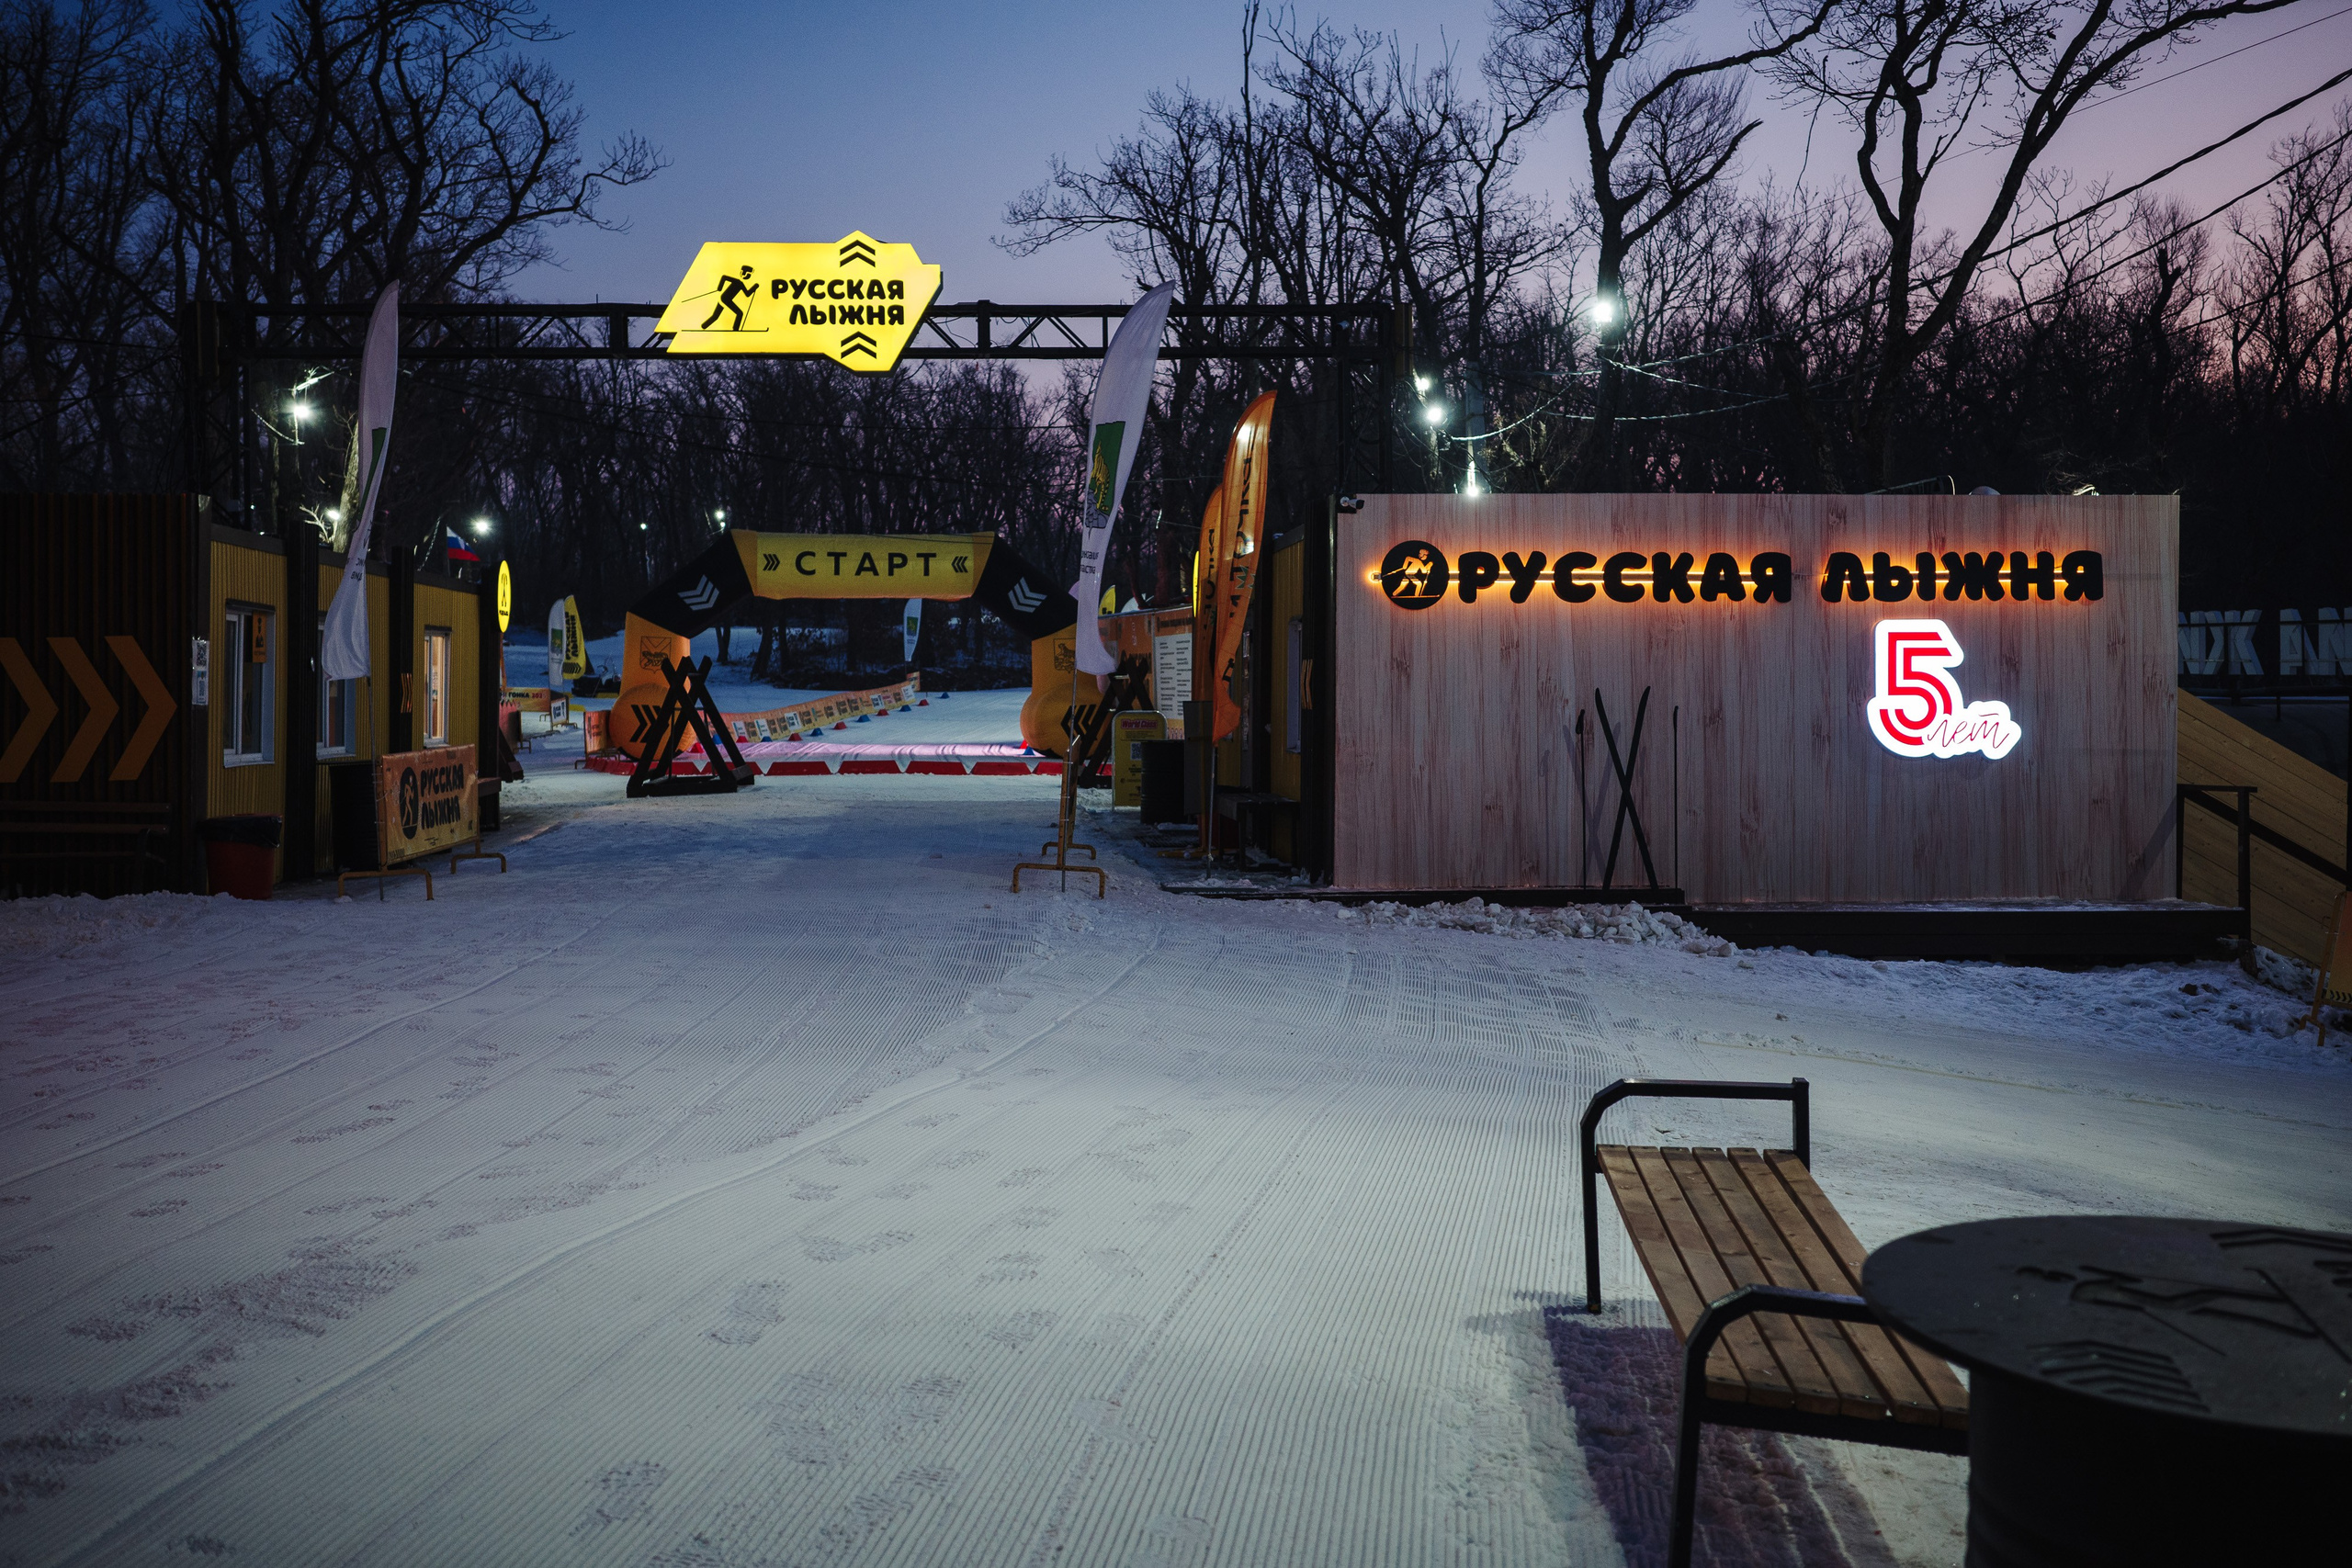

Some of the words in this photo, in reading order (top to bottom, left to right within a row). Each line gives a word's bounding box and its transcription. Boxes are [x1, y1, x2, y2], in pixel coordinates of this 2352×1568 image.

[771, 279, 904, 300] РУССКАЯ
[789, 304, 905, 325] ЛЫЖНЯ
[795, 550, 937, 577] СТАРТ
[1456, 551, 1792, 604] РУССКАЯ
[1821, 550, 2104, 604] ЛЫЖНЯ
[1880, 632, 1952, 746] 5
[1927, 713, 2009, 749] лет
[1122, 719, 1140, 729] World
[1141, 719, 1158, 729] Class
[421, 763, 464, 796] РУССКАЯ
[422, 795, 461, 830] ЛЫЖНЯ
